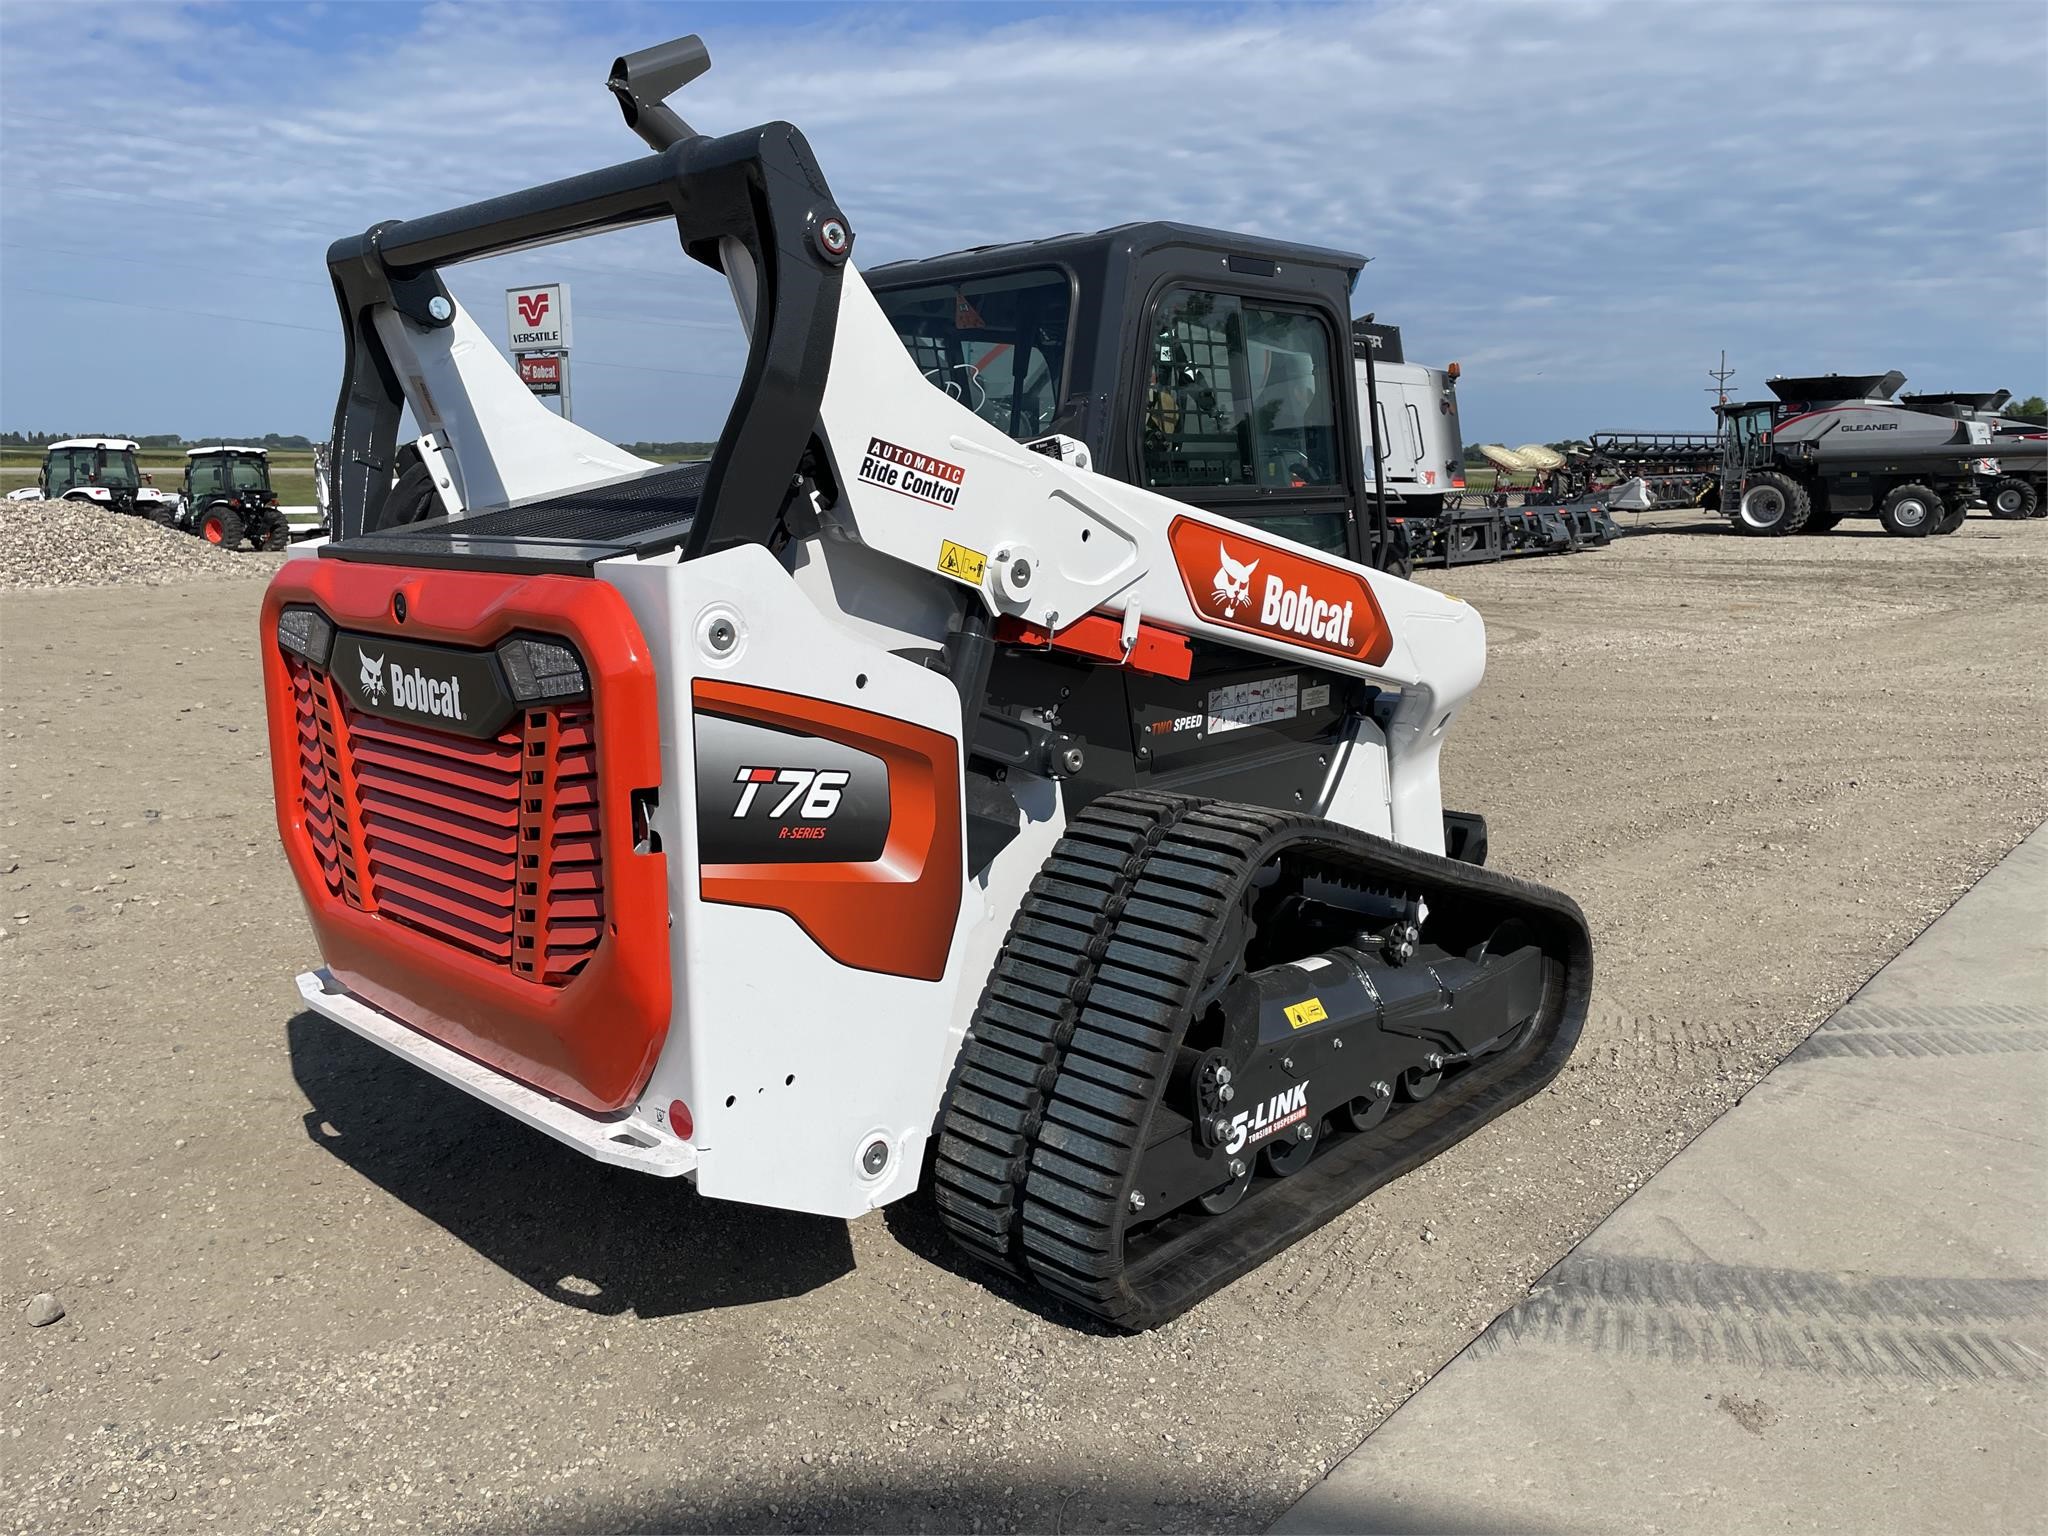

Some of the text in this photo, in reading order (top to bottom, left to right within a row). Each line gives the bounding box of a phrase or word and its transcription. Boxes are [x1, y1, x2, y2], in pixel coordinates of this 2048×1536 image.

[513, 331, 559, 343] VERSATILE
[532, 364, 556, 379] Bobcat
[1841, 423, 1898, 432] GLEANER
[859, 456, 960, 506] Ride Control
[870, 441, 962, 483] AUTOMATIC
[1260, 574, 1353, 647] Bobcat
[390, 663, 462, 720] Bobcat
[1151, 714, 1203, 735] TWO SPEED
[732, 766, 850, 819] T76
[779, 827, 827, 839] R-SERIES
[1225, 1080, 1310, 1155] 5-LINK
[1248, 1105, 1307, 1144] TORSION SUSPENSION
